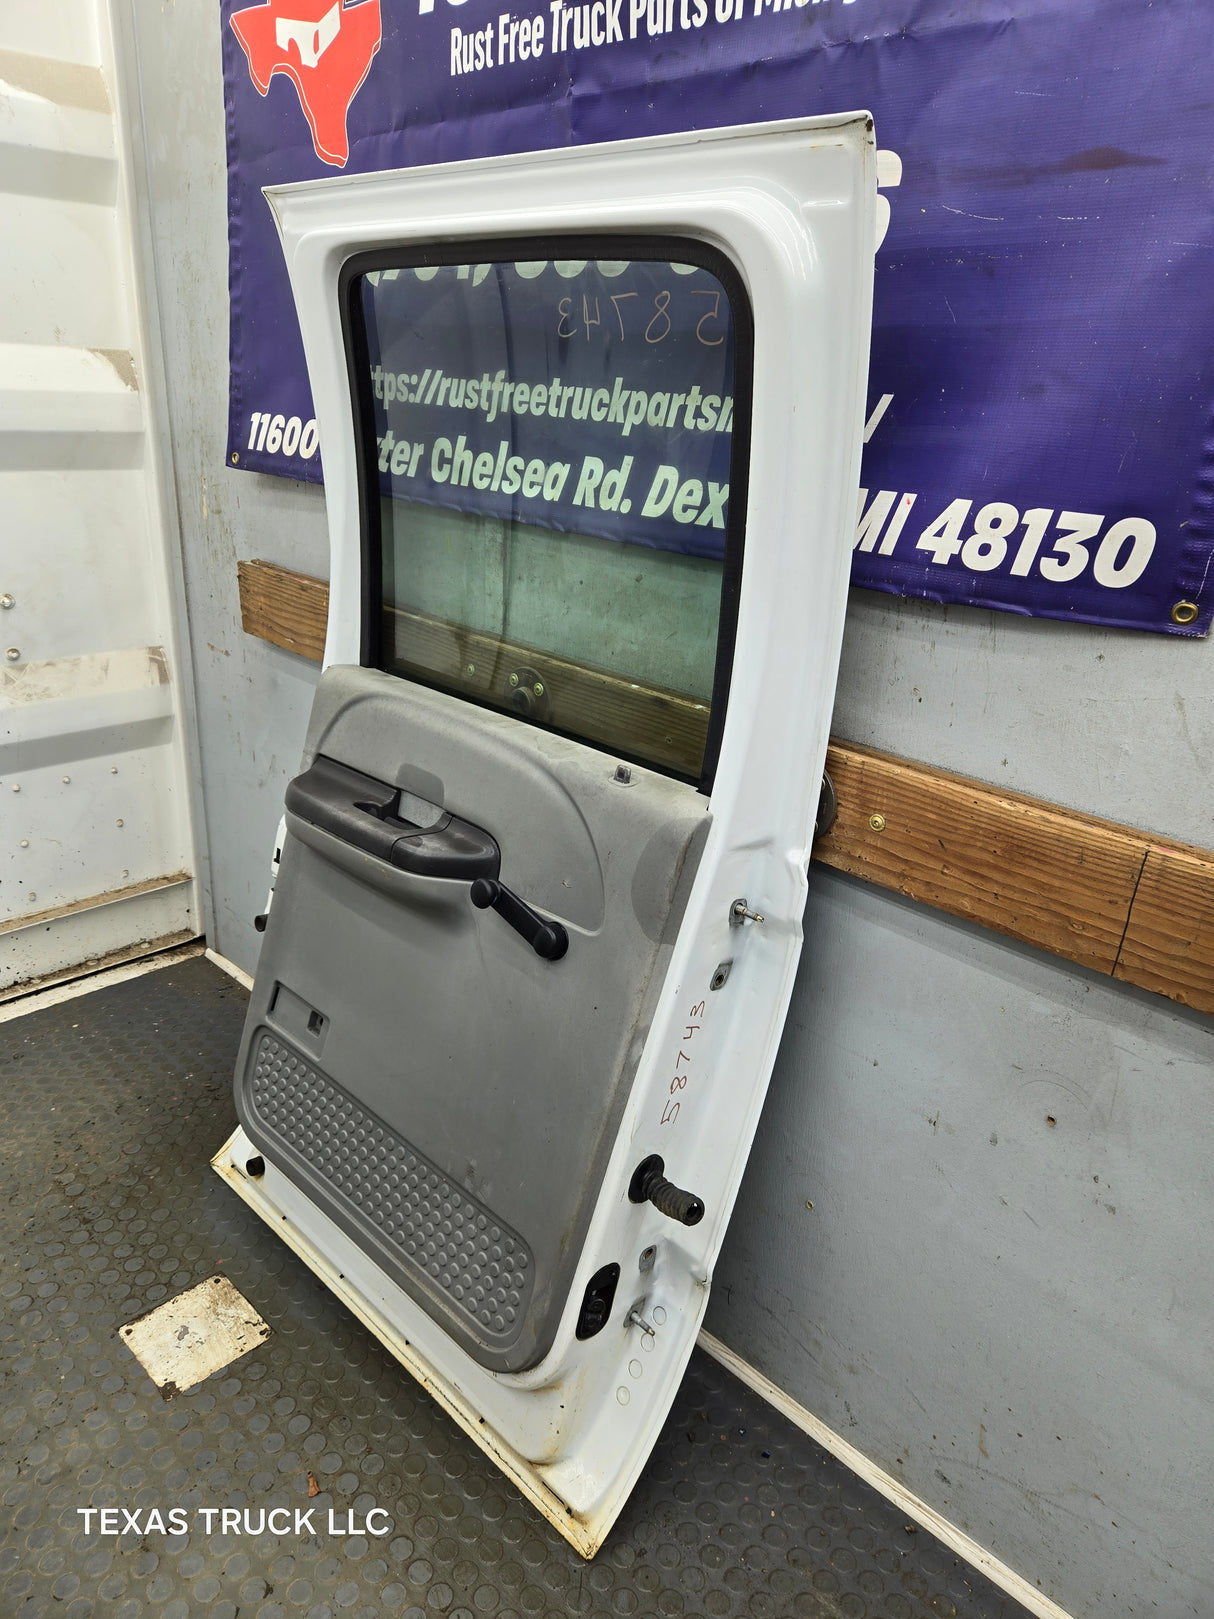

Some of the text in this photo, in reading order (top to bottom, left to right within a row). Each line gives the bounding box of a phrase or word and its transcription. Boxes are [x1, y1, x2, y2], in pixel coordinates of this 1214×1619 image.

[450, 23, 494, 76] Rust
[498, 13, 545, 66] Free
[550, 0, 623, 53] Truck
[247, 411, 320, 460] 11600
[377, 430, 425, 478] ter
[431, 435, 571, 502] Chelsea
[572, 455, 634, 514] Rd.
[915, 498, 1158, 589] 48130
[660, 1000, 706, 1126] 58743
